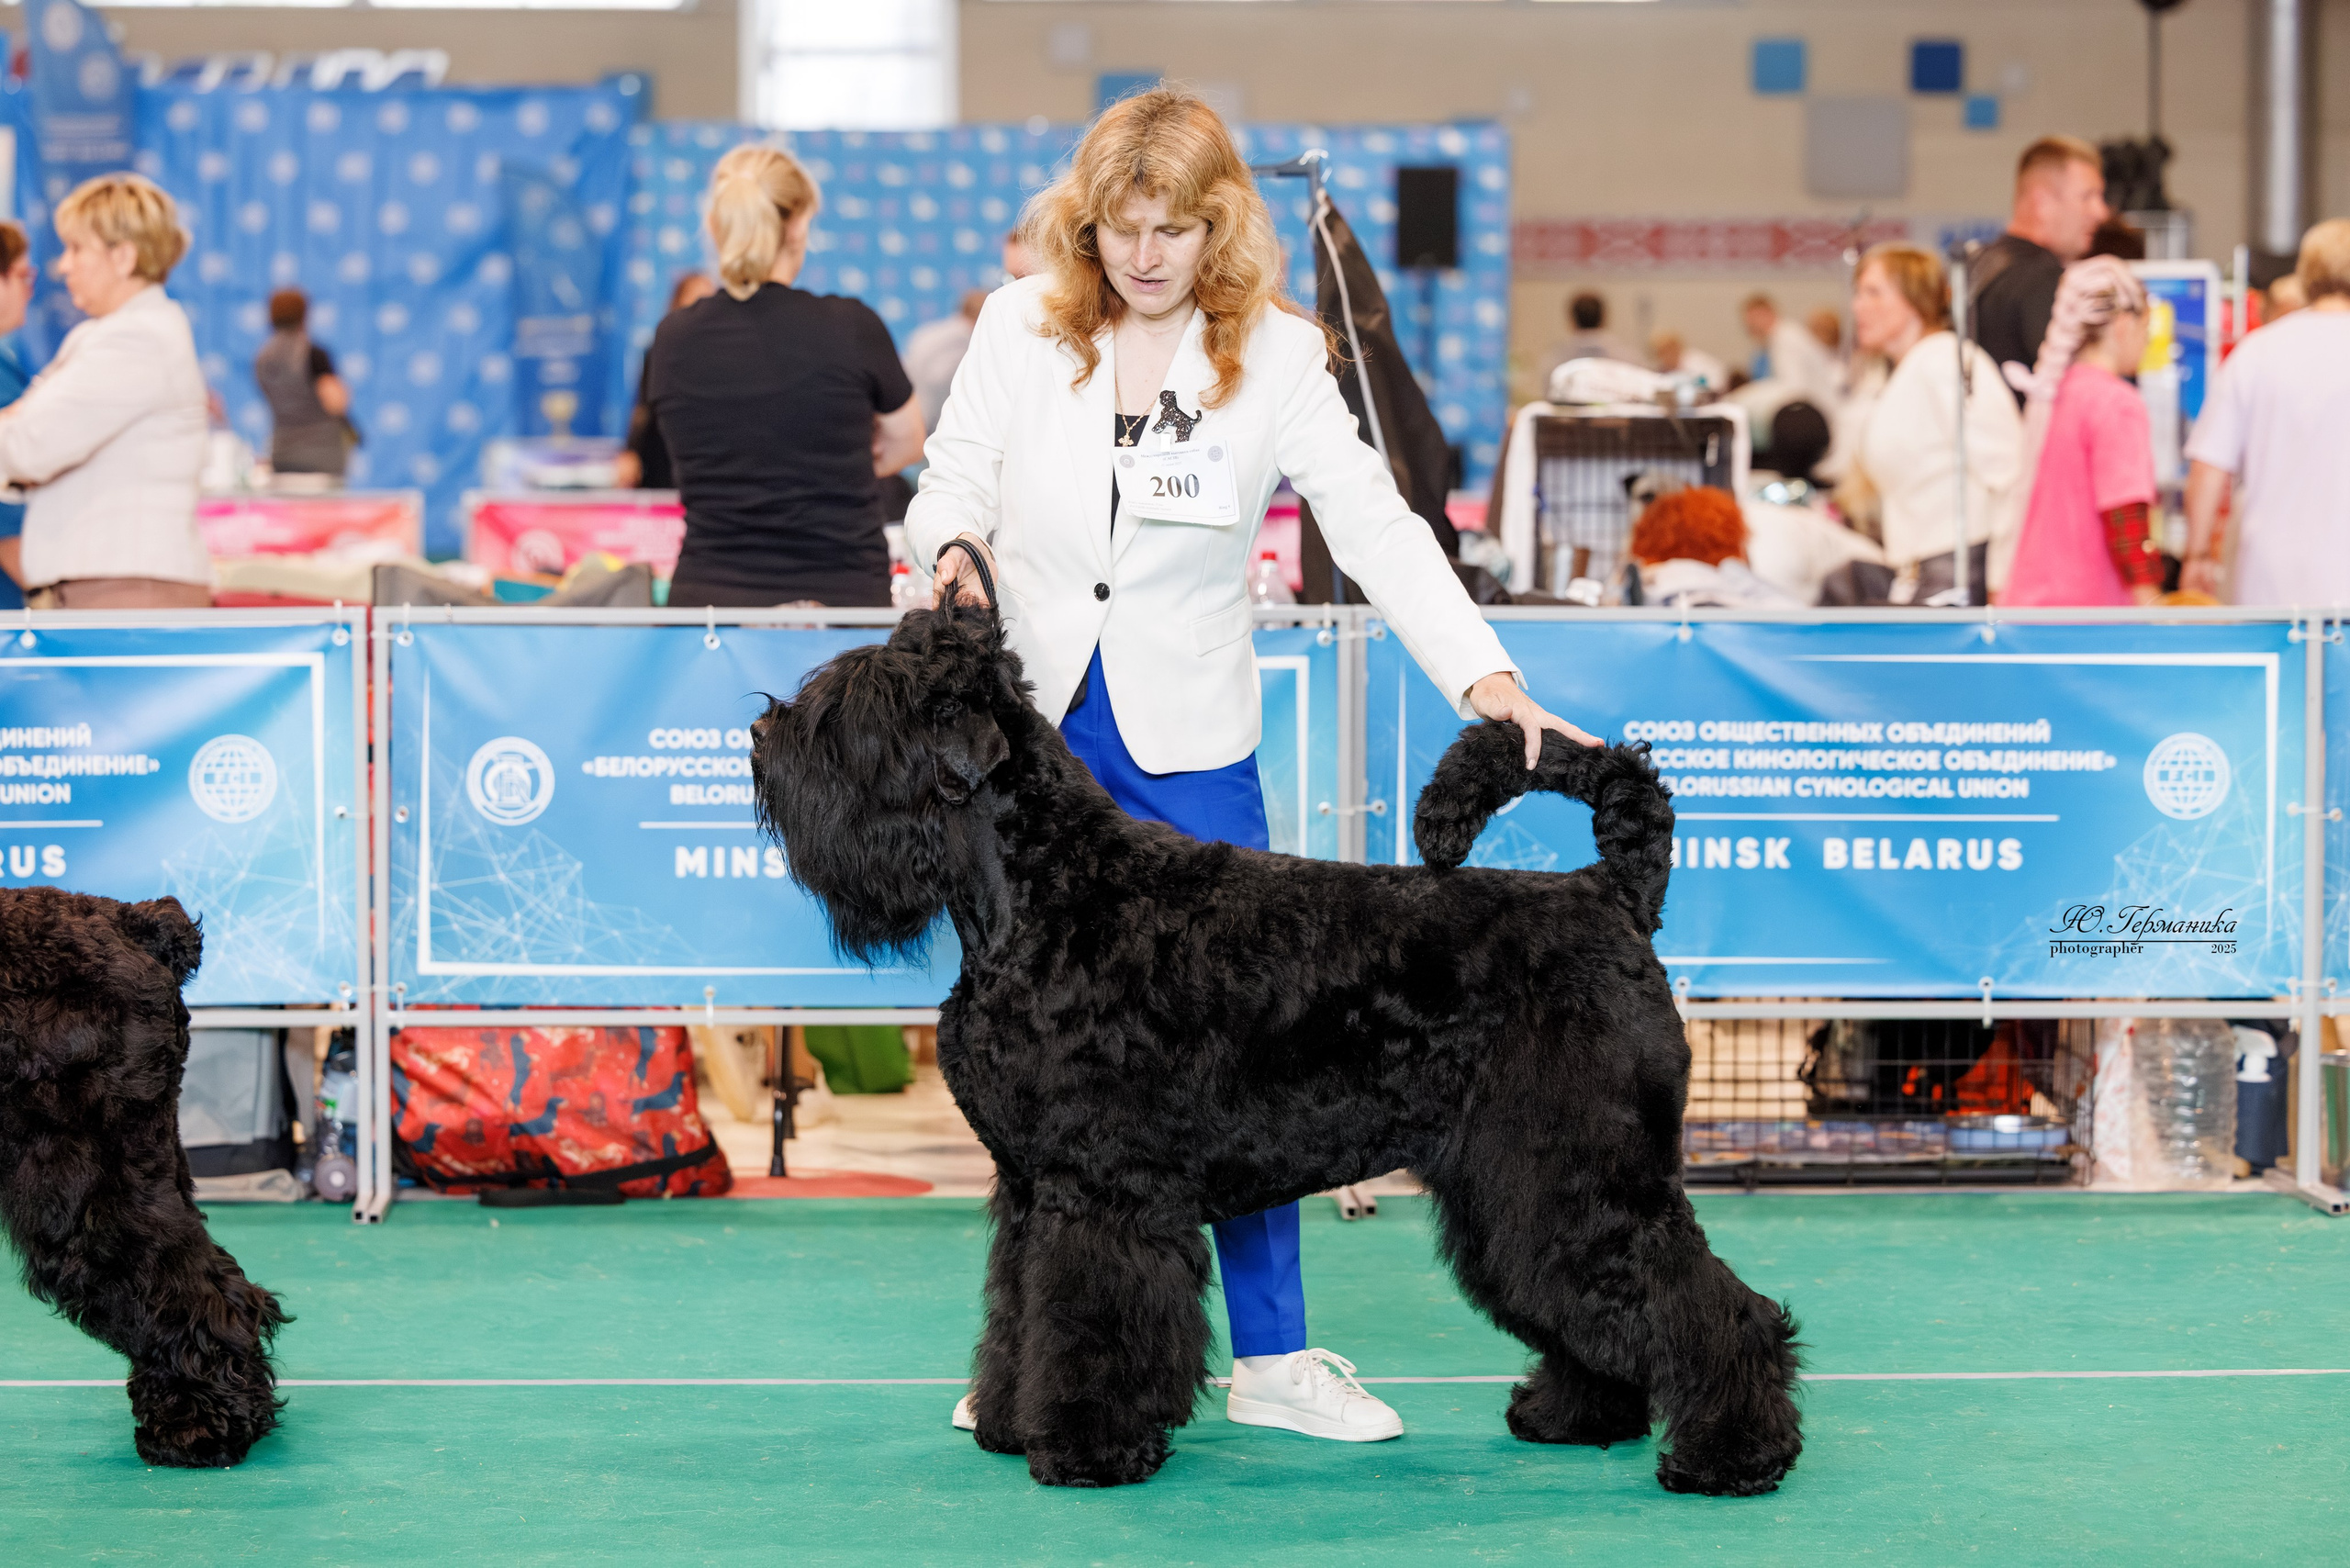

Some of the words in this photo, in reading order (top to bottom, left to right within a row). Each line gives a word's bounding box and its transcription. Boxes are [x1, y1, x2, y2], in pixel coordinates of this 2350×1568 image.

[1149, 473, 1200, 498] 200
[0, 722, 92, 750] ИНЕНИЙ
[648, 728, 722, 750] СОЮЗ
[1623, 721, 1696, 742] СОЮЗ
[1698, 721, 1884, 745] ОБЩЕСТВЕННЫХ
[1886, 718, 2052, 746] ОБЪЕДИНЕНИЙ
[0, 754, 161, 778] БЪЕДИНЕНИЕ»
[1733, 749, 1942, 771] КИНОЛОГИЧЕСКОЕ
[0, 782, 72, 804] UNION
[1794, 777, 1955, 798] CYNOLOGICAL
[1957, 777, 2030, 799] UNION
[0, 844, 67, 879] US
[1823, 837, 2023, 871] BELARUS
